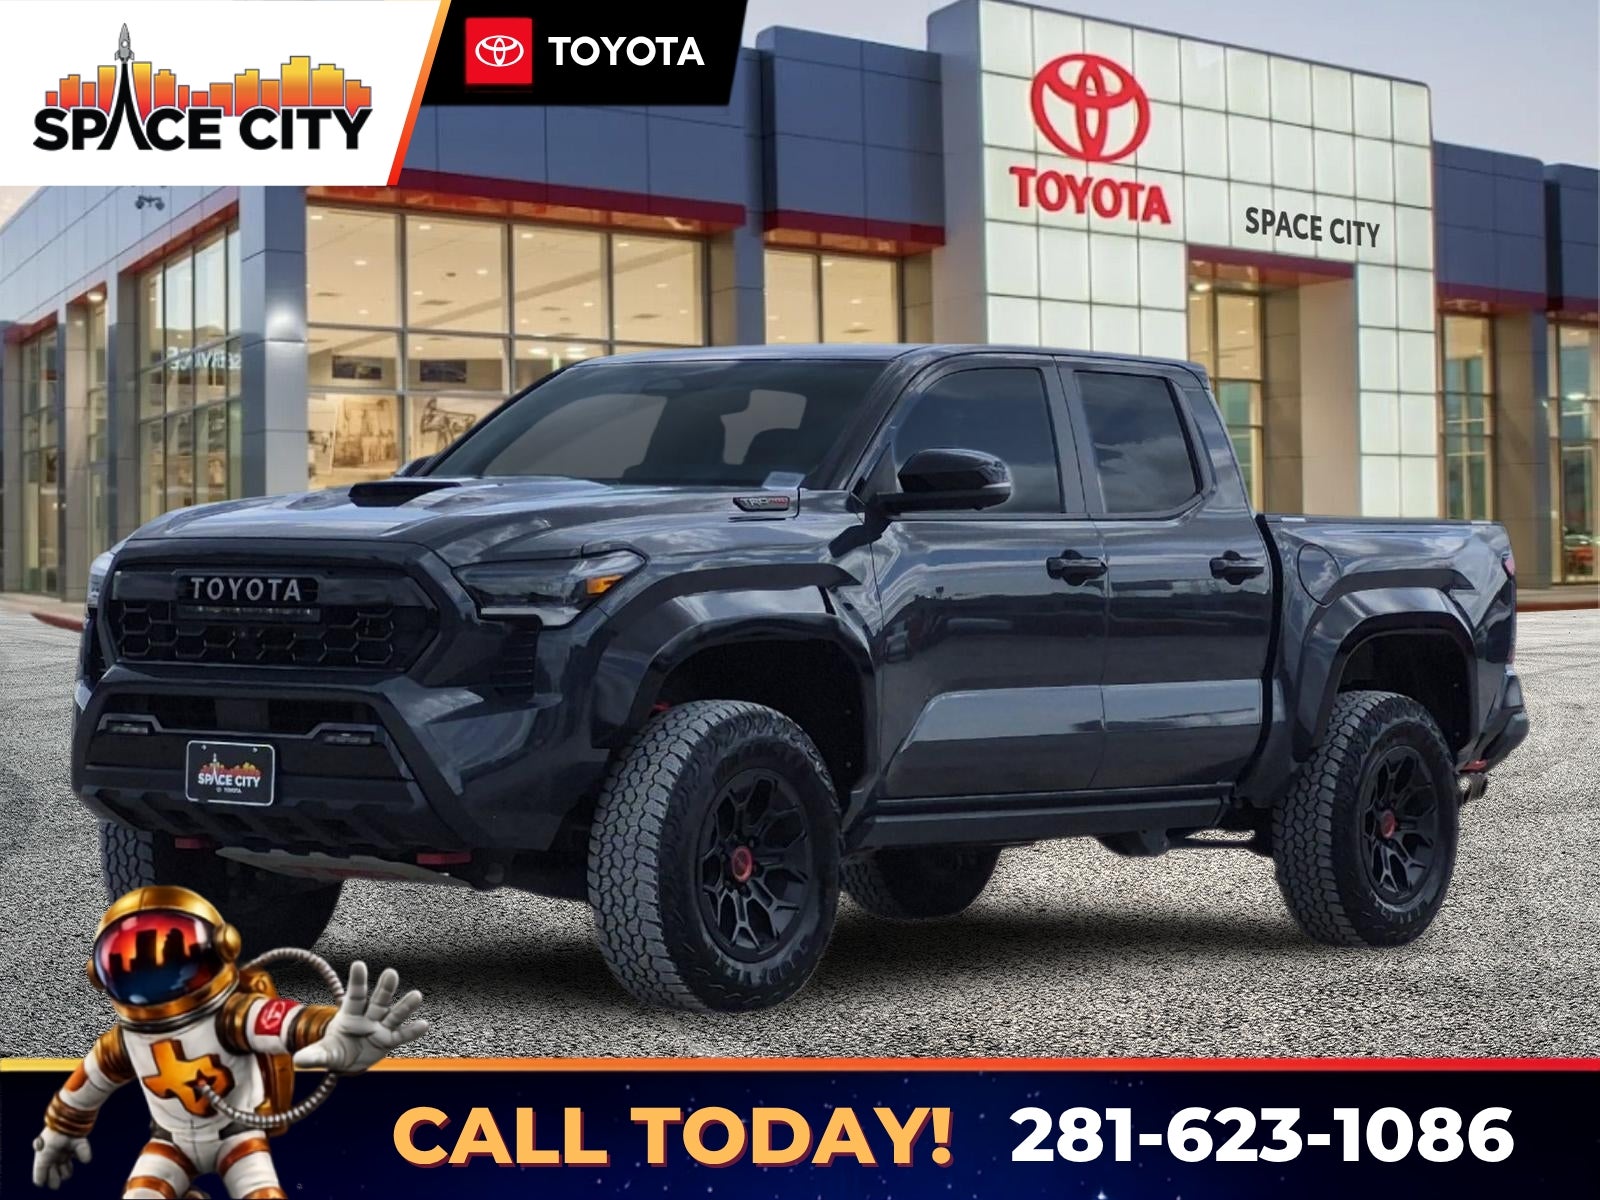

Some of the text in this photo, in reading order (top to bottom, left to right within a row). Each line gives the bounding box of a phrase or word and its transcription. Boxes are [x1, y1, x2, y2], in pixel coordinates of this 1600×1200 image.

[1009, 166, 1171, 224] TOYOTA
[1245, 206, 1380, 248] SPACE CITY
[190, 577, 302, 602] TOYOTA
[197, 771, 262, 788] SPACE CITY
